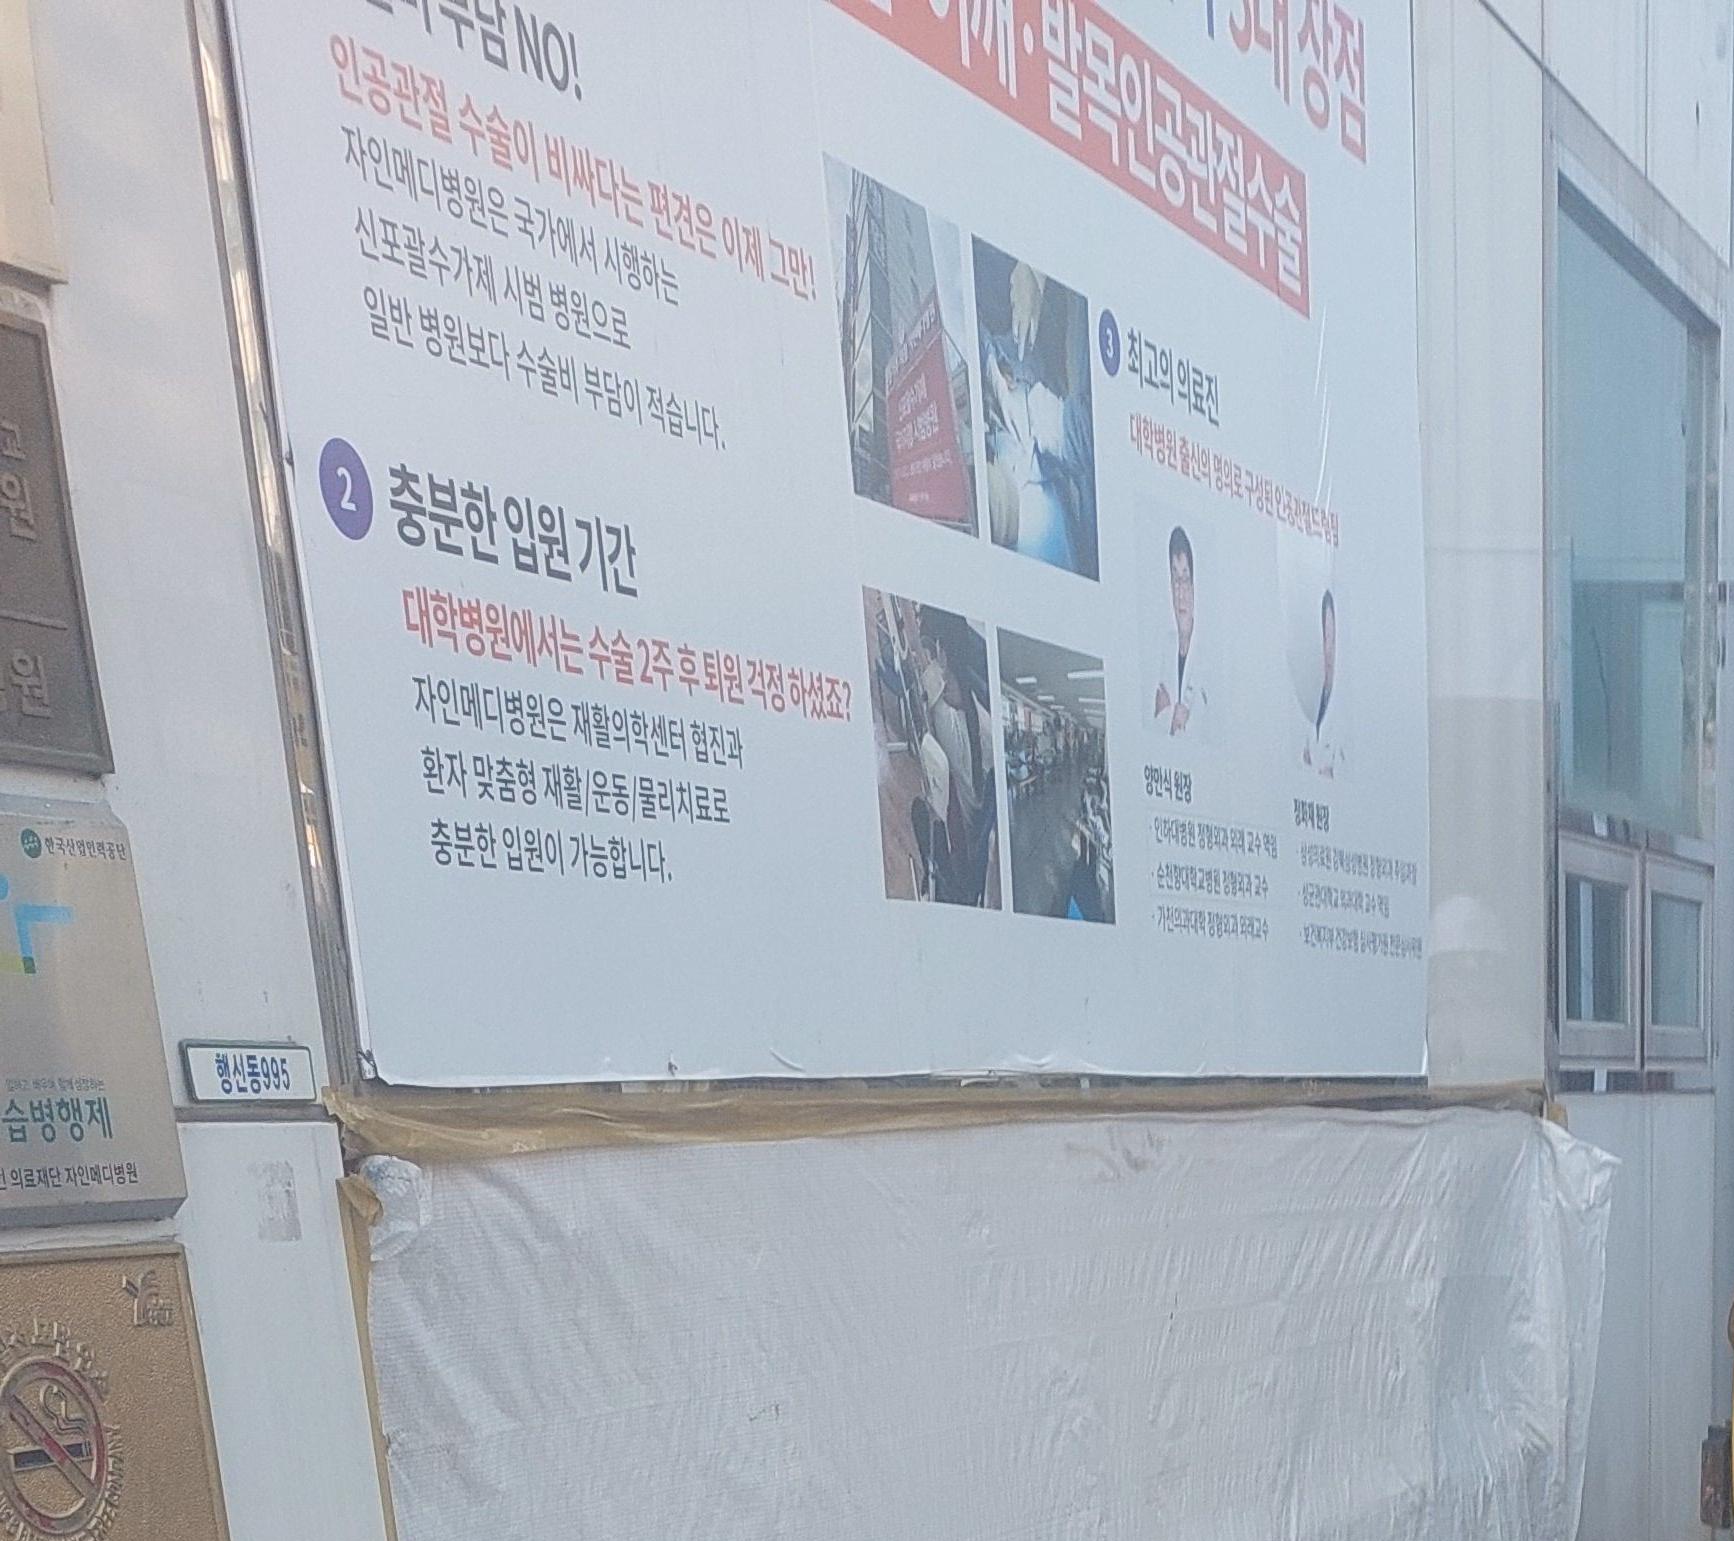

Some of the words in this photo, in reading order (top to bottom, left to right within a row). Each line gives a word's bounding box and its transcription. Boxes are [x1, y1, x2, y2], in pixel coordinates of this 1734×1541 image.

[512, 4, 582, 101] NO!
[329, 33, 453, 145] 인공관절
[458, 93, 540, 182] 수술이
[545, 132, 645, 228] 비싸다는
[648, 180, 717, 259] 편견은
[721, 213, 765, 284] 이제
[769, 238, 817, 301] 그만!
[340, 125, 509, 238] 자인메디병원은
[513, 196, 599, 275] 국가에서
[603, 237, 680, 307] 시행하는
[353, 206, 498, 305] 신포괄수가제
[503, 266, 545, 322] 시범
[549, 283, 633, 350] 병원으로
[363, 287, 414, 348] 일반
[418, 303, 511, 380] 병원보다
[516, 339, 580, 405] 수술비
[583, 361, 643, 427] 부담이
[646, 384, 727, 451] 적습니다.
[1127, 326, 1175, 409] 최고의
[1177, 358, 1221, 427] 의료진
[336, 464, 359, 513] 2
[1128, 412, 1178, 470] 대학병원
[1179, 435, 1212, 489] 출신의
[1213, 452, 1244, 502] 명의로
[1245, 468, 1274, 518] 구성된
[387, 462, 500, 566] 충분한
[503, 494, 573, 584] 입원
[574, 516, 640, 600] 기간
[401, 585, 585, 678] 대학병원에서는
[587, 624, 636, 686] 수술
[638, 637, 675, 687] 2주
[677, 642, 702, 692] 후
[702, 649, 746, 706] 퇴원
[746, 658, 787, 713] 걱정
[787, 667, 854, 723] 하셨죠?
[411, 673, 569, 744] 자인메디병원은
[572, 699, 688, 765] 재활의학센터
[689, 717, 744, 772] 협진과
[420, 745, 468, 800] 환자
[472, 749, 538, 806] 맞춤형
[1173, 769, 1193, 804] 원장
[430, 817, 498, 872] 충분한
[502, 826, 565, 878] 입원이
[569, 832, 674, 886] 가능합니다.
[1197, 823, 1229, 853] 정형외과
[1246, 830, 1263, 858] 교수
[1253, 872, 1270, 899] 교수
[10, 1166, 62, 1190] 의료재단
[65, 1161, 139, 1188] 자인메디병원
